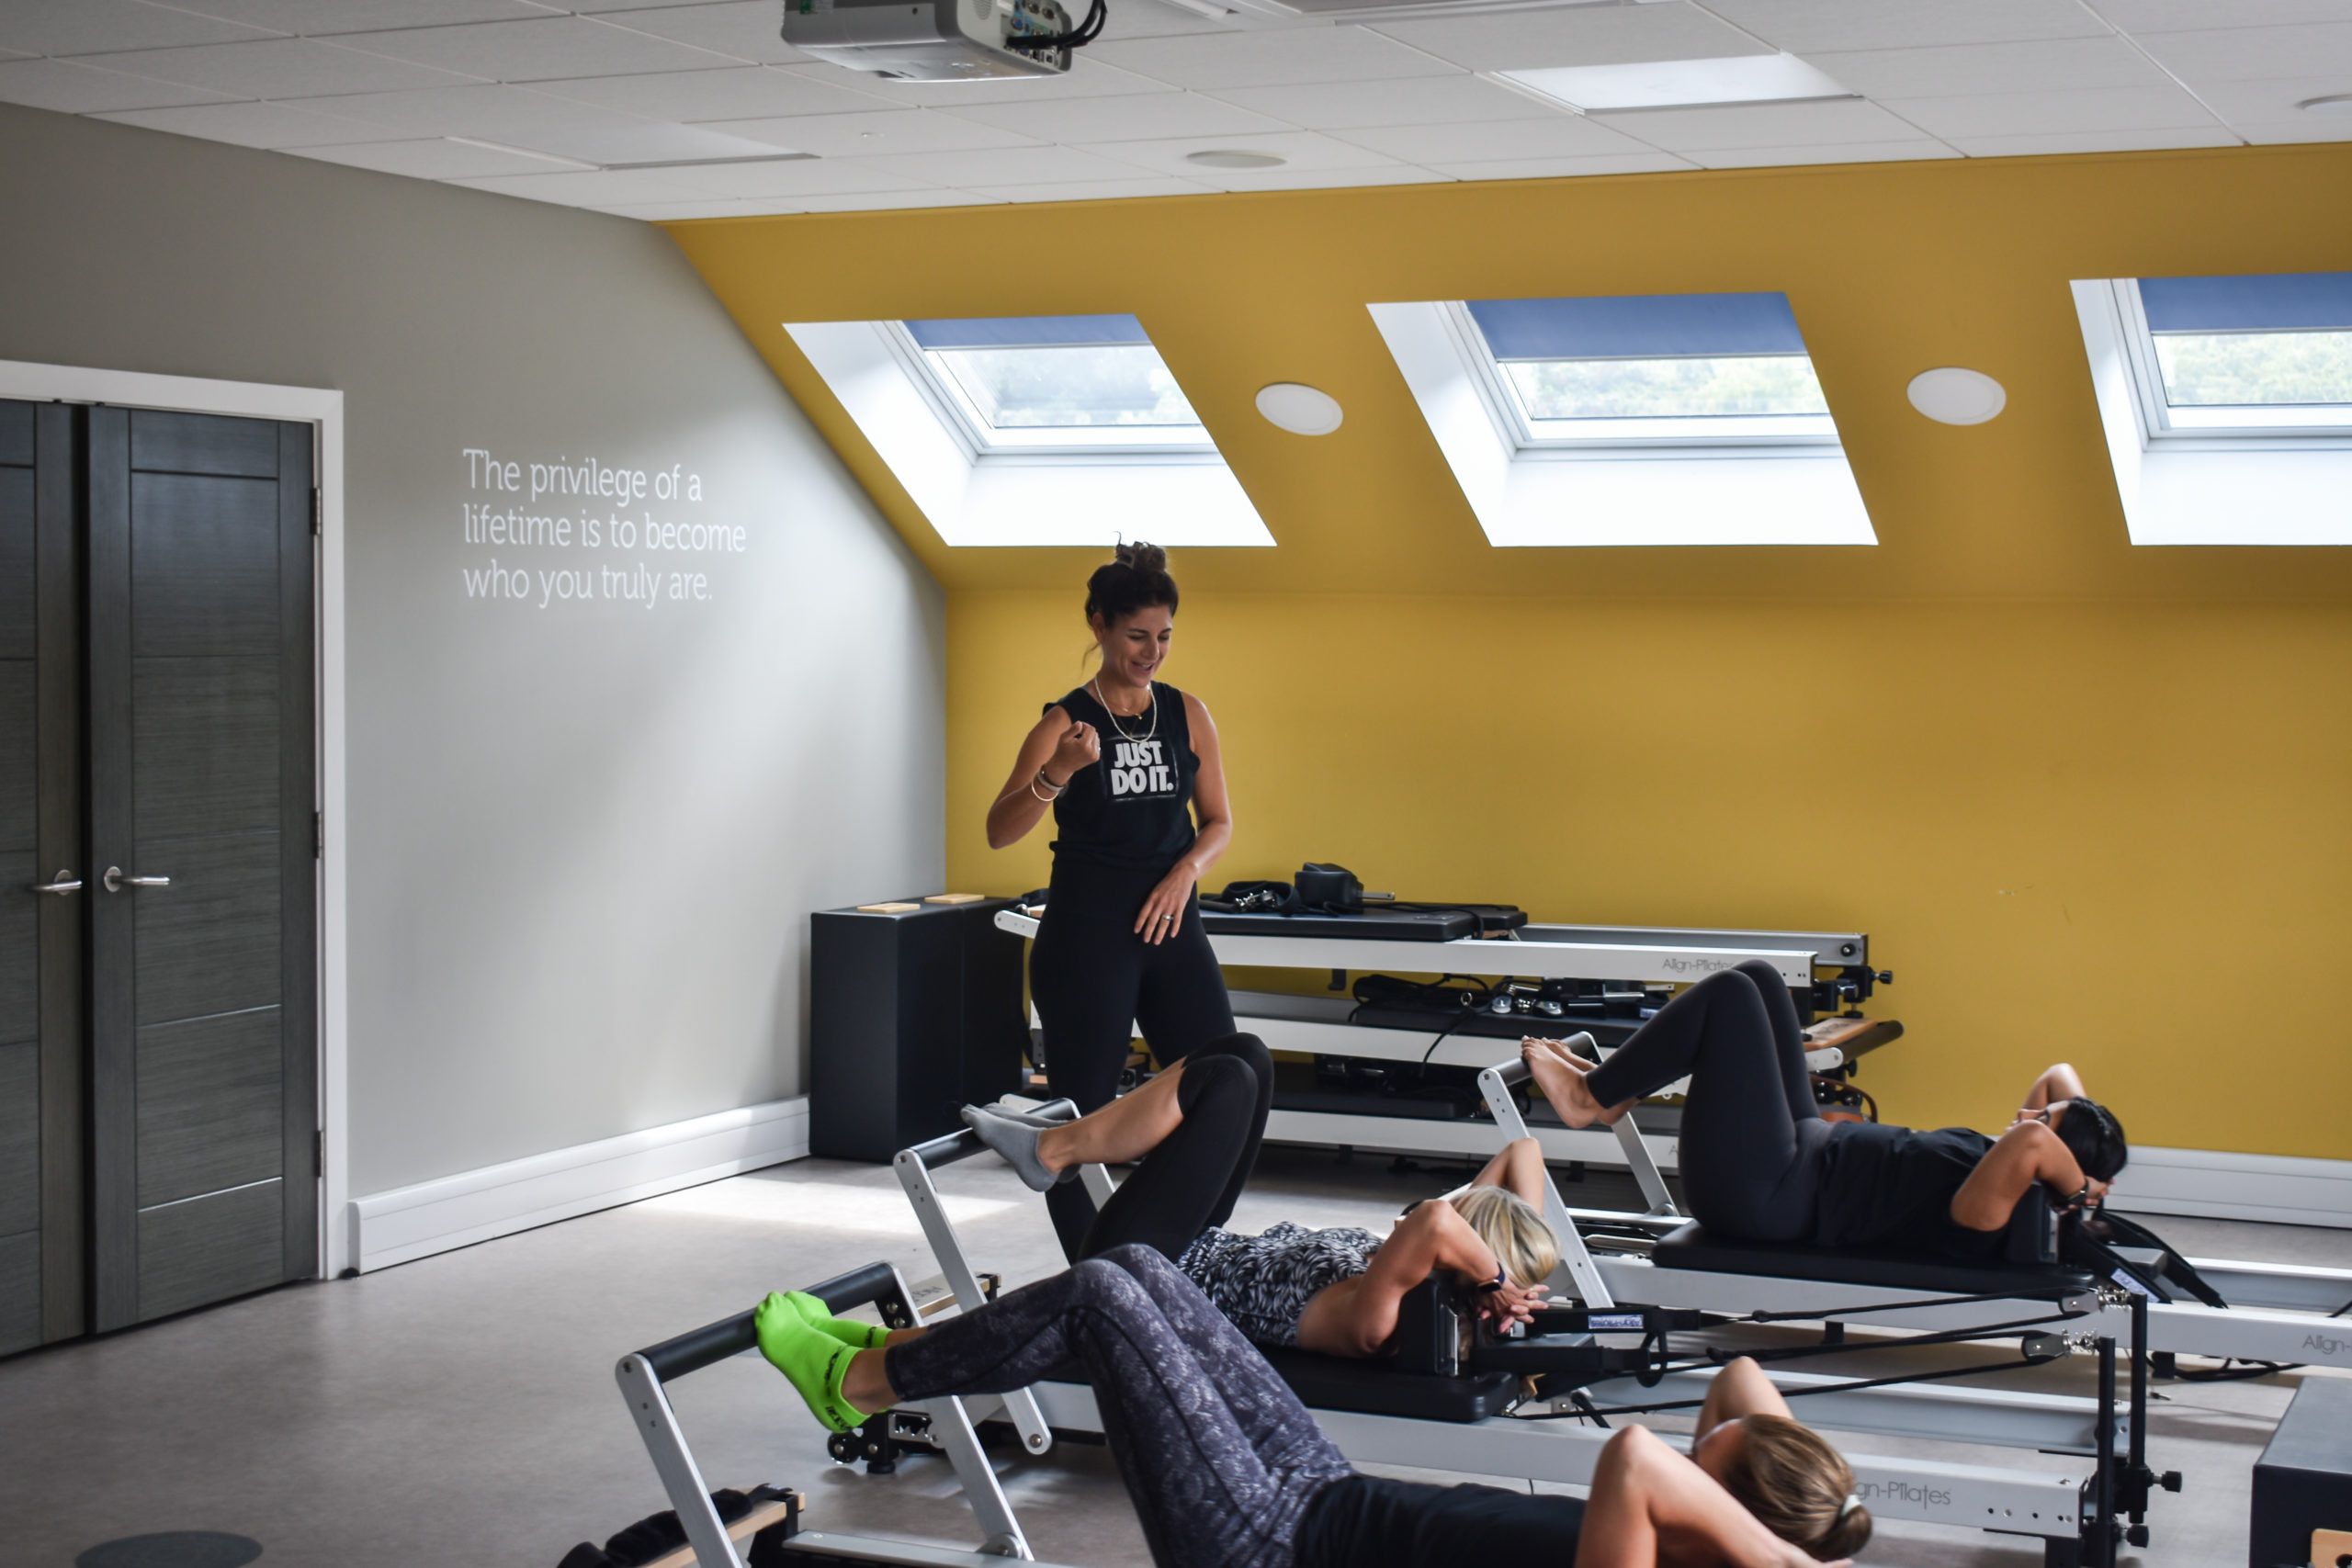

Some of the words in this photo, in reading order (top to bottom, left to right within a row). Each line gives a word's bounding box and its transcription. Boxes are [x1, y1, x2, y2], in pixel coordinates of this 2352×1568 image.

[462, 448, 520, 491] The
[530, 456, 646, 507] privilege
[655, 463, 682, 500] of
[688, 473, 703, 502] a
[463, 503, 571, 547] lifetime
[581, 509, 601, 547] is
[610, 513, 637, 548] to
[645, 512, 746, 552] become
[463, 558, 529, 599] who
[538, 570, 593, 609] you
[601, 562, 662, 610] truly
[669, 571, 713, 600] are.
[1114, 740, 1163, 768] JUST
[1110, 767, 1148, 795] DO
[1148, 765, 1174, 793] IT.
